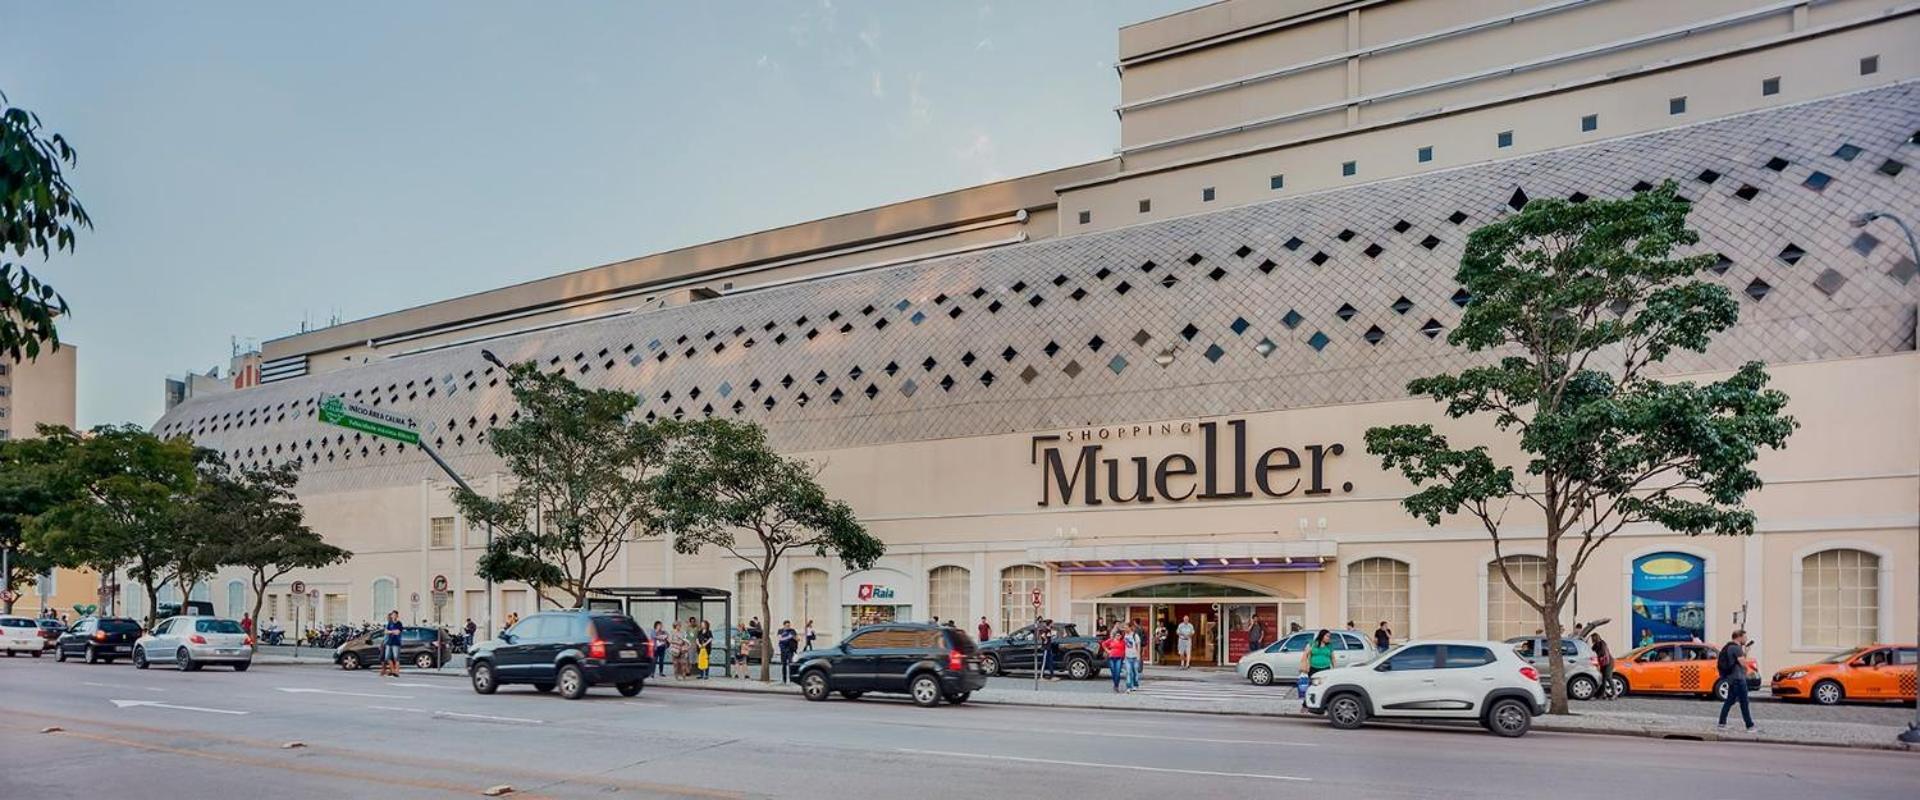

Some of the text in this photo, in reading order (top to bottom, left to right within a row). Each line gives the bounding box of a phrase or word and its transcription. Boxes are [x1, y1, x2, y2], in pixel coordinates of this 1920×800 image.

[349, 404, 368, 416] INÍCIO
[369, 408, 384, 420] ÁREA
[385, 414, 405, 425] CALMA
[1066, 422, 1191, 441] SHOPPING
[873, 588, 894, 599] Raia
